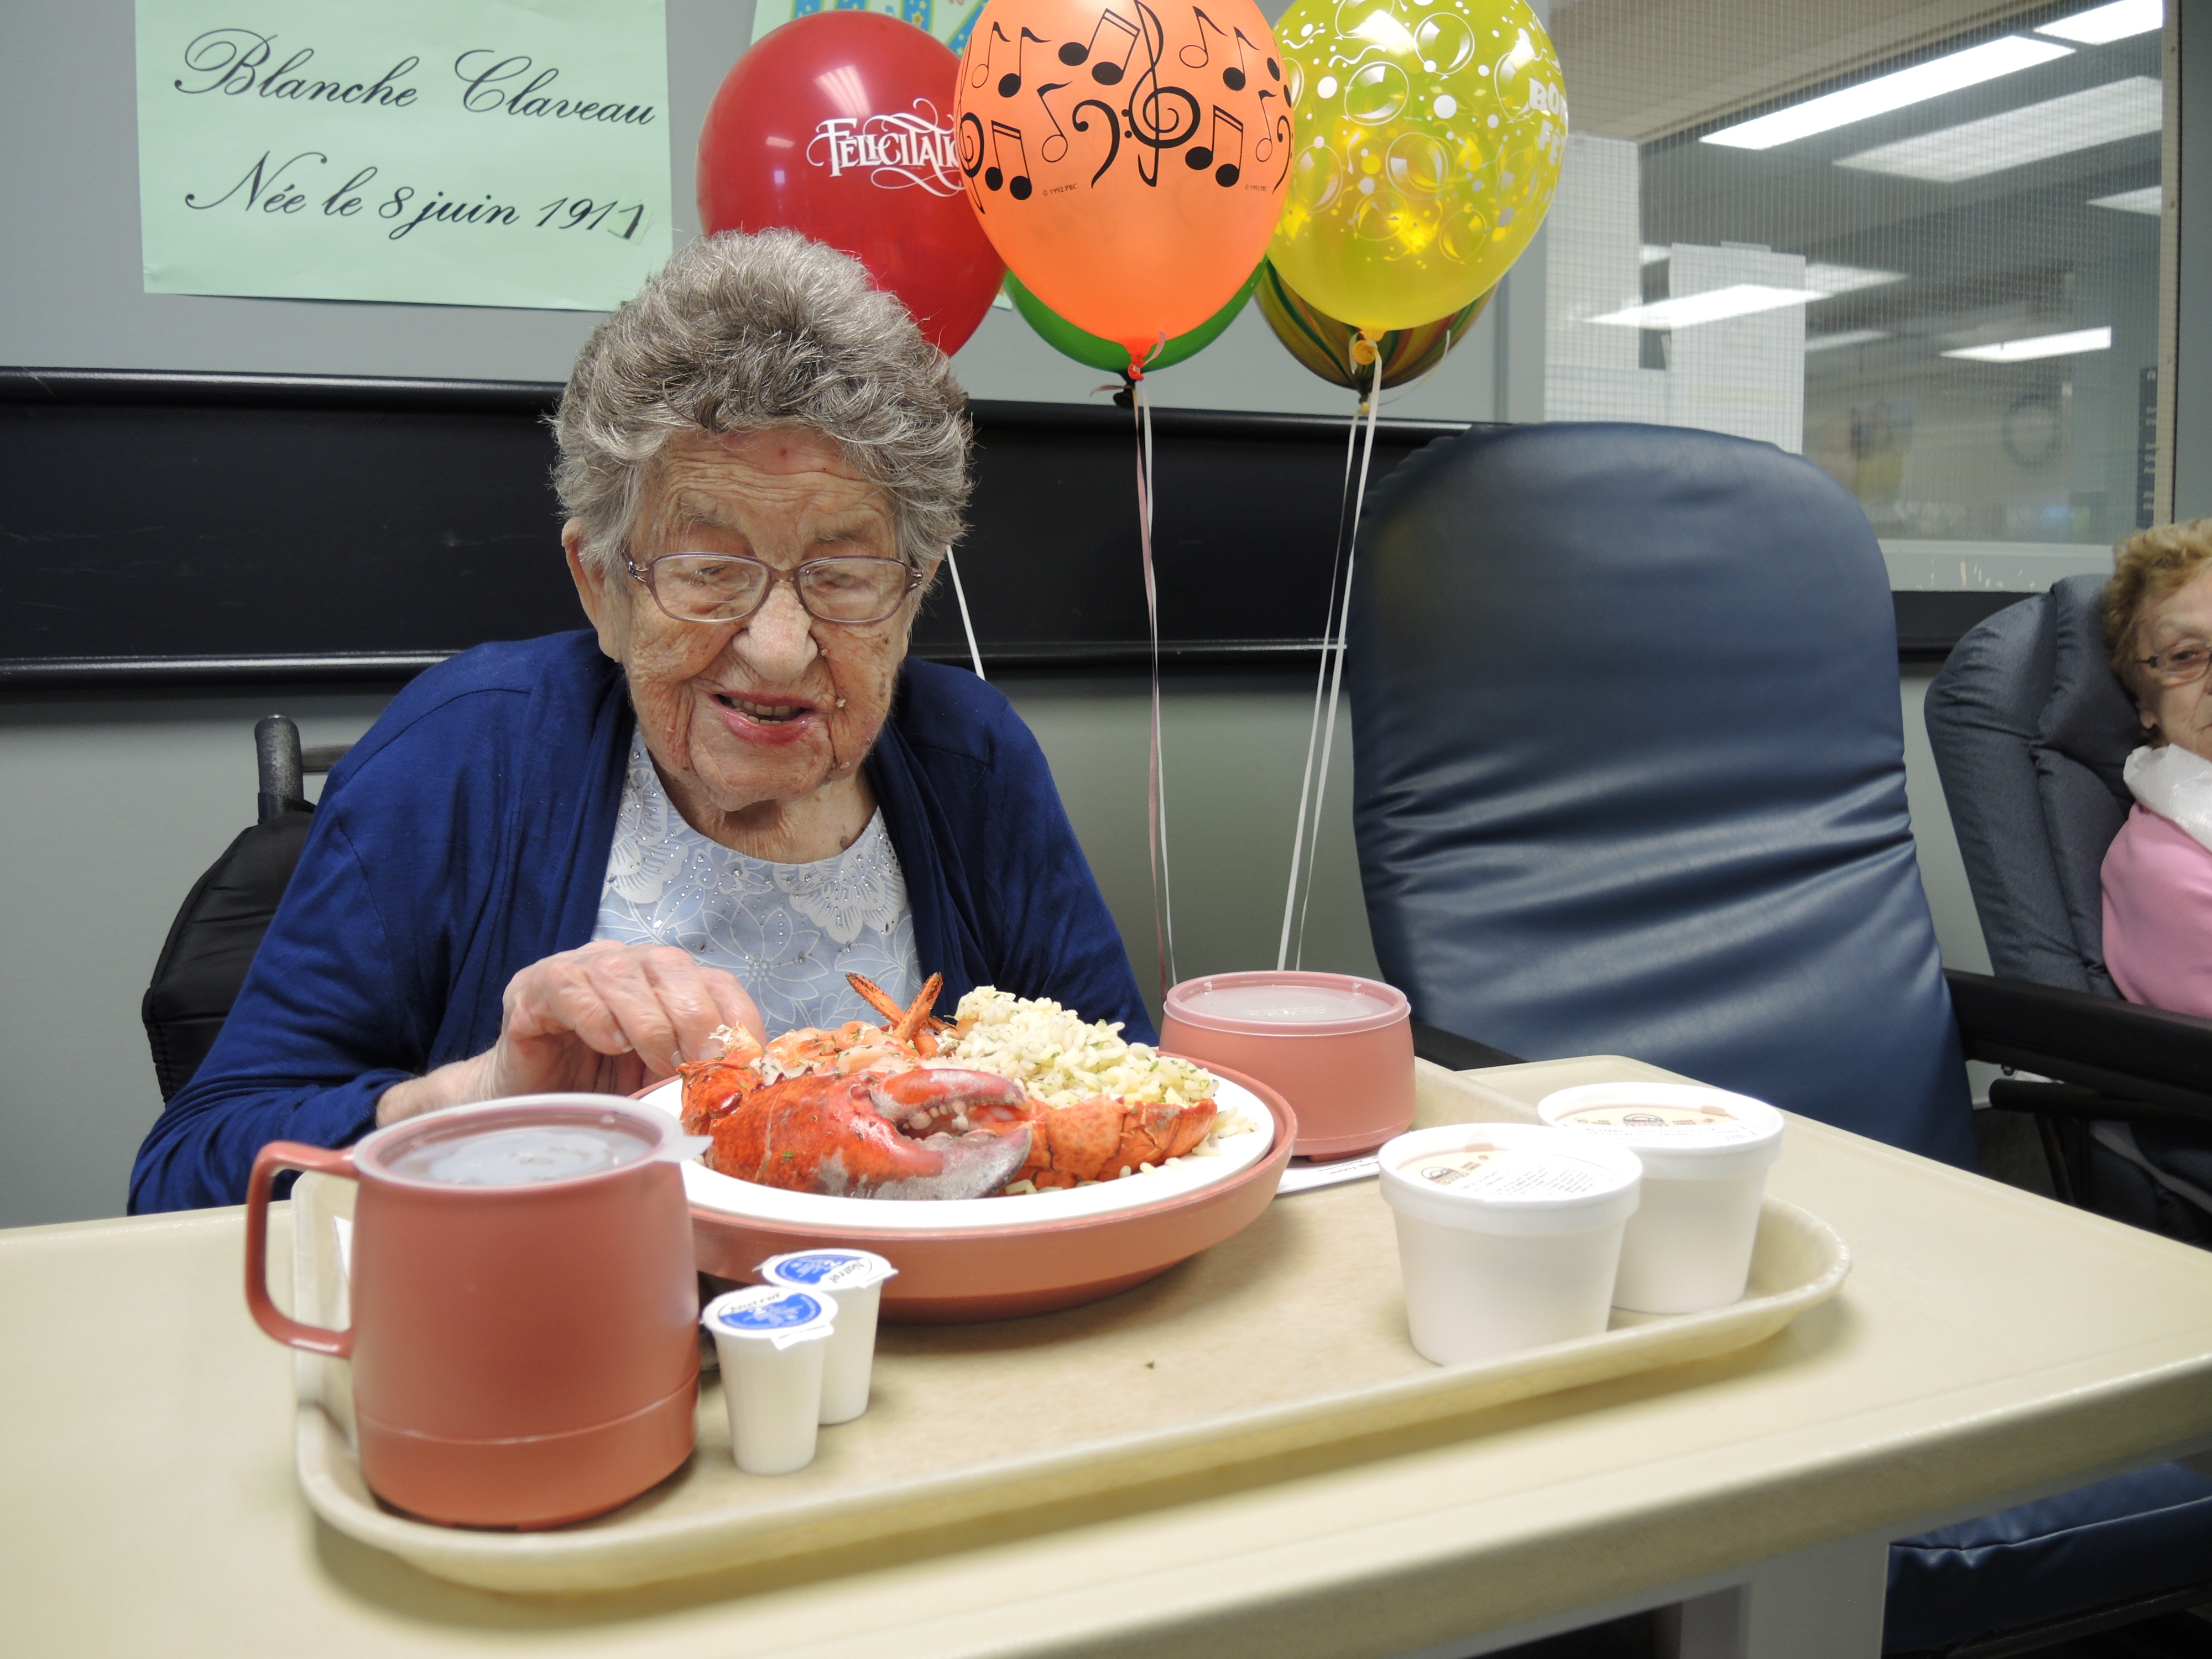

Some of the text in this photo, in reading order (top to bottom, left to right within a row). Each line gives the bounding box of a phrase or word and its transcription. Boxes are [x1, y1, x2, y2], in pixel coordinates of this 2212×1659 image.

[174, 29, 655, 126] Blanche Claveau
[185, 151, 327, 214] Née
[322, 166, 378, 217] le
[379, 186, 415, 219] 8
[1050, 186, 1064, 195] 1992
[1065, 183, 1078, 191] PBC
[389, 191, 520, 241] juin
